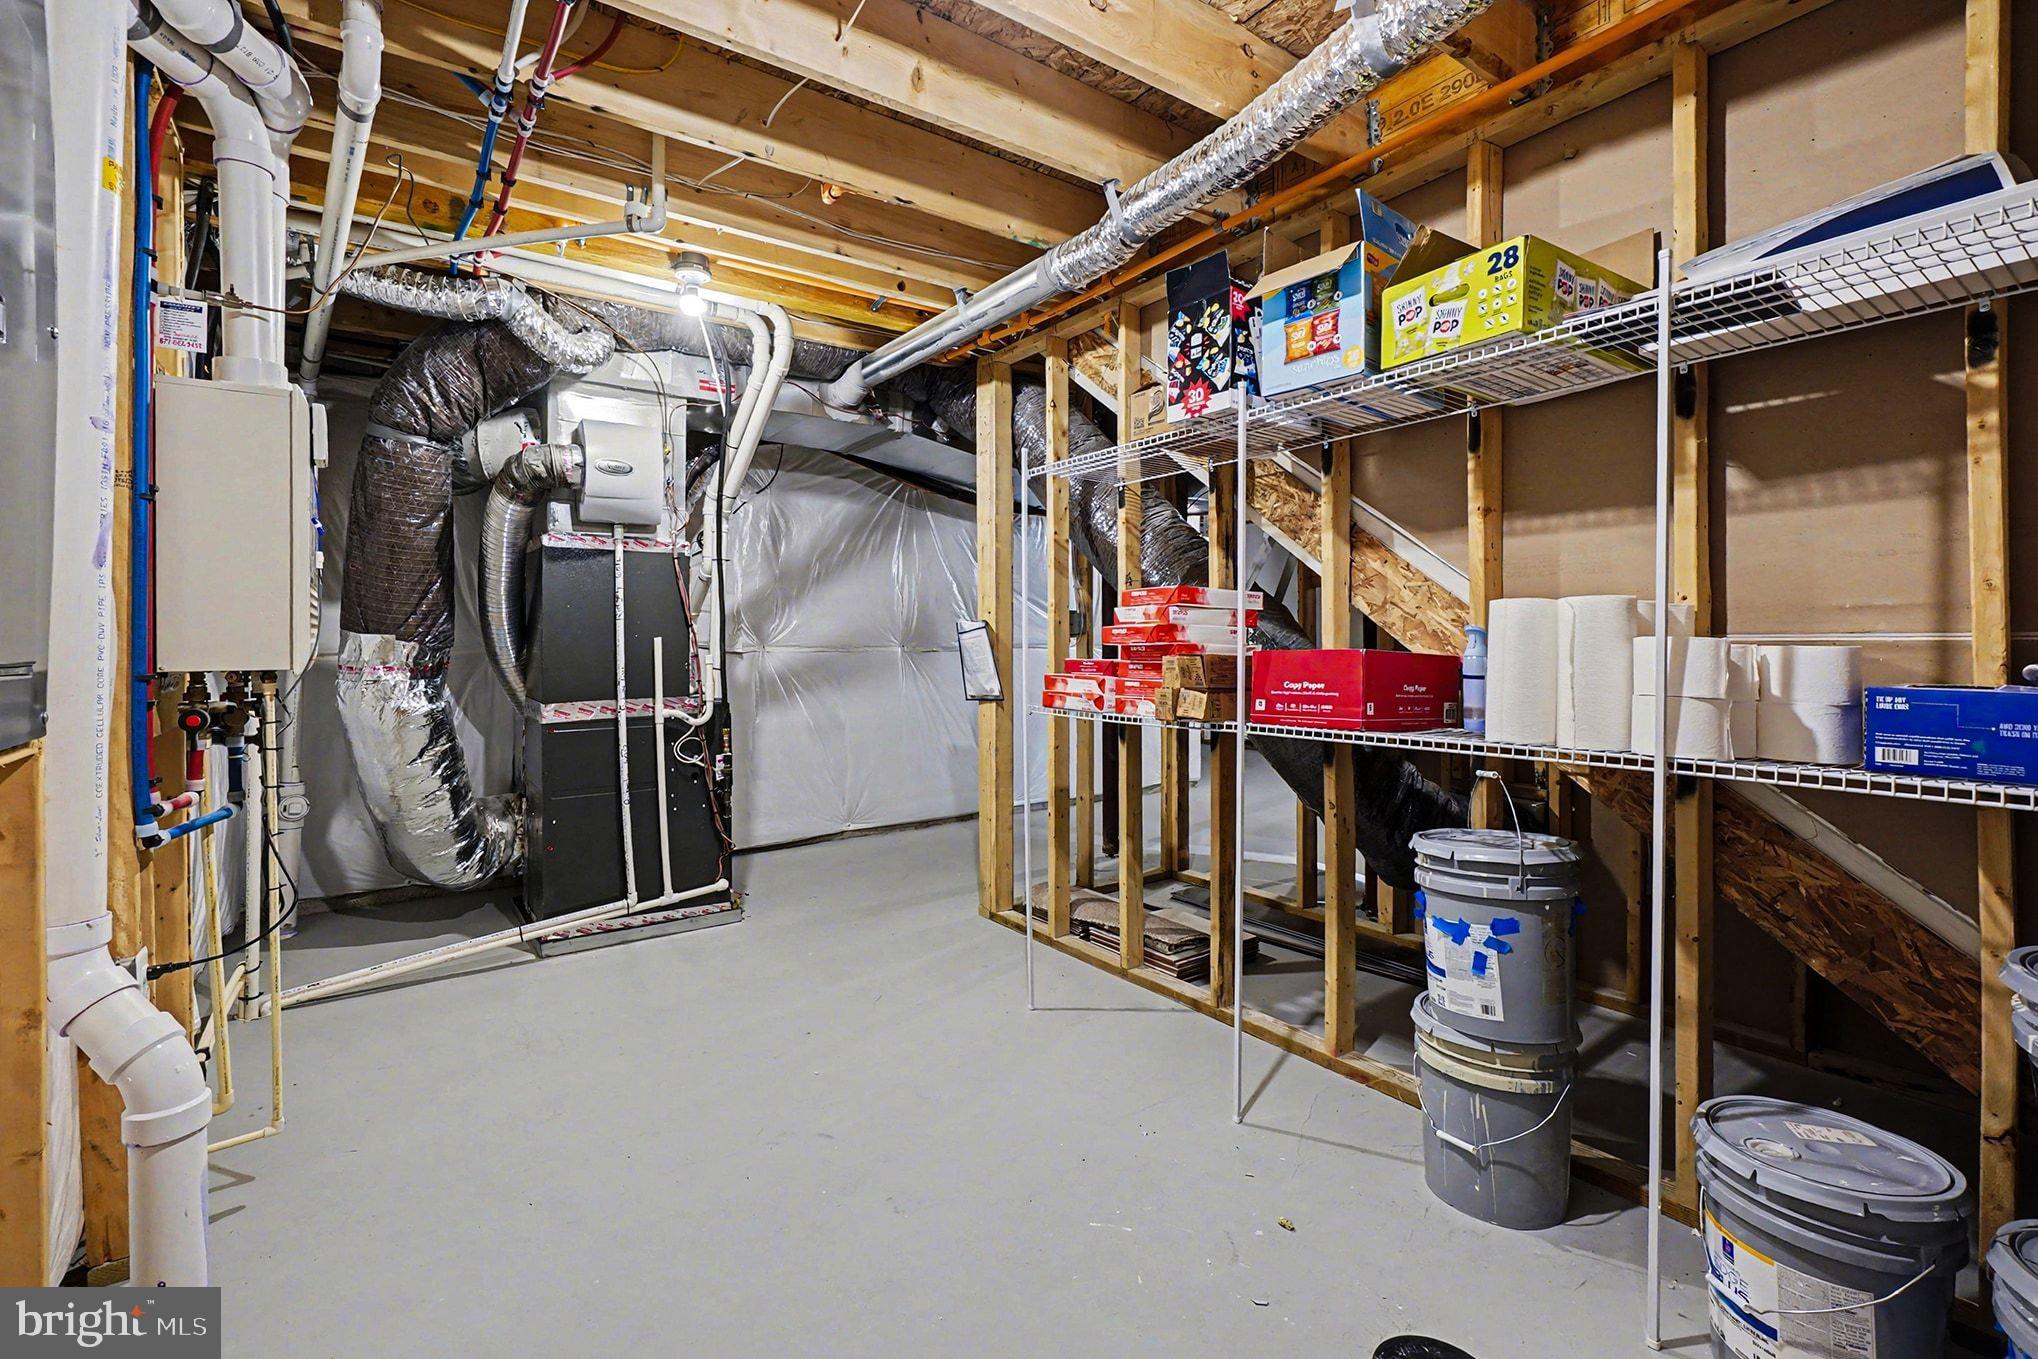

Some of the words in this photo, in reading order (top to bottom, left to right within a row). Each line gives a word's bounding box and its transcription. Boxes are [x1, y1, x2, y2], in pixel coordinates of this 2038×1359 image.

[1392, 91, 1434, 127] 2.0E
[1487, 244, 1520, 276] 28
[1494, 270, 1514, 283] BAGS
[1557, 278, 1573, 297] POP
[1396, 293, 1423, 315] SKINNY
[1398, 305, 1423, 327] POP
[1433, 319, 1460, 334] POP
[1187, 387, 1205, 401] 30
[97, 595, 107, 618] PIPE
[95, 666, 105, 689] CORE
[1283, 681, 1302, 690] Copy
[1303, 681, 1325, 690] Paper
[95, 693, 105, 738] CELLULAR
